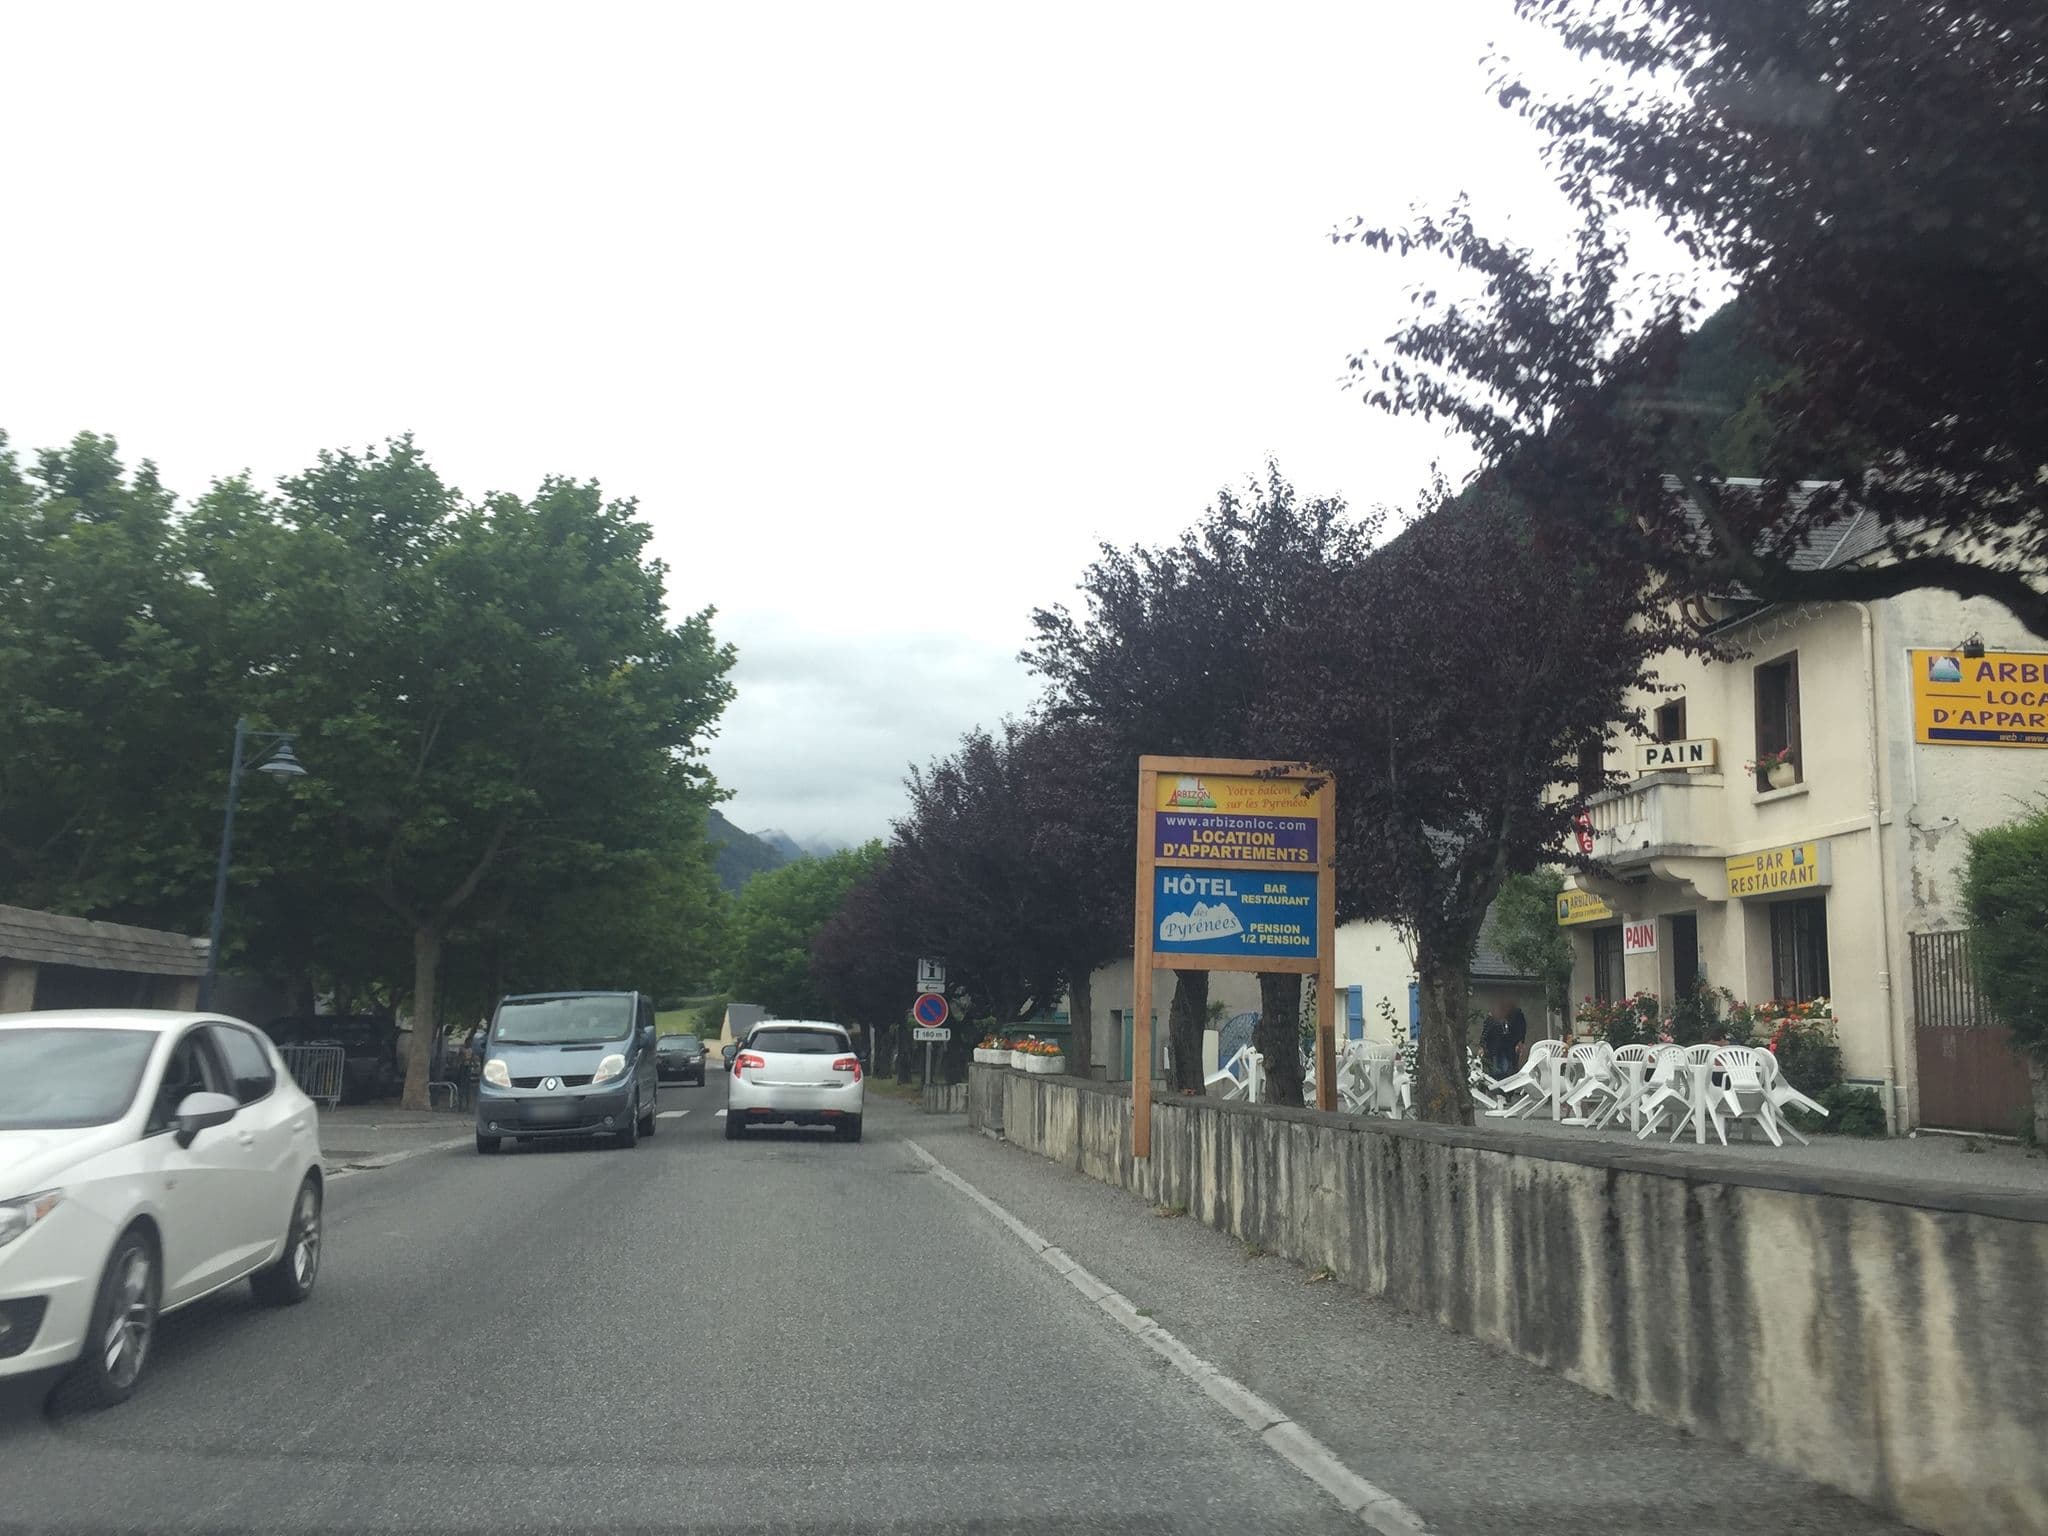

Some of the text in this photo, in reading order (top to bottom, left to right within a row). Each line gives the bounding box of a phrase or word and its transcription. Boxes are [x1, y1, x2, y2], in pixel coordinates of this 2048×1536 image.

[1933, 708, 2048, 727] D'APPAR
[1646, 744, 1703, 765] PAIN
[1225, 783, 1292, 797] Votre balcon
[1225, 801, 1243, 809] sur
[1245, 799, 1260, 809] les
[1166, 816, 1306, 831] www.arbizonloc.com
[1192, 830, 1276, 846] LOCATION
[1163, 843, 1309, 862] D'APPARTEMENTS
[1756, 852, 1784, 872] BAR
[1163, 873, 1238, 897] HÔTEL
[1731, 864, 1815, 894] RESTAURANT
[1263, 883, 1288, 894] BAR
[1241, 894, 1310, 906] RESTAURANT
[1249, 923, 1301, 935] PENSION
[1625, 923, 1654, 950] PAIN
[1240, 934, 1310, 946] 1/2 PENSION
